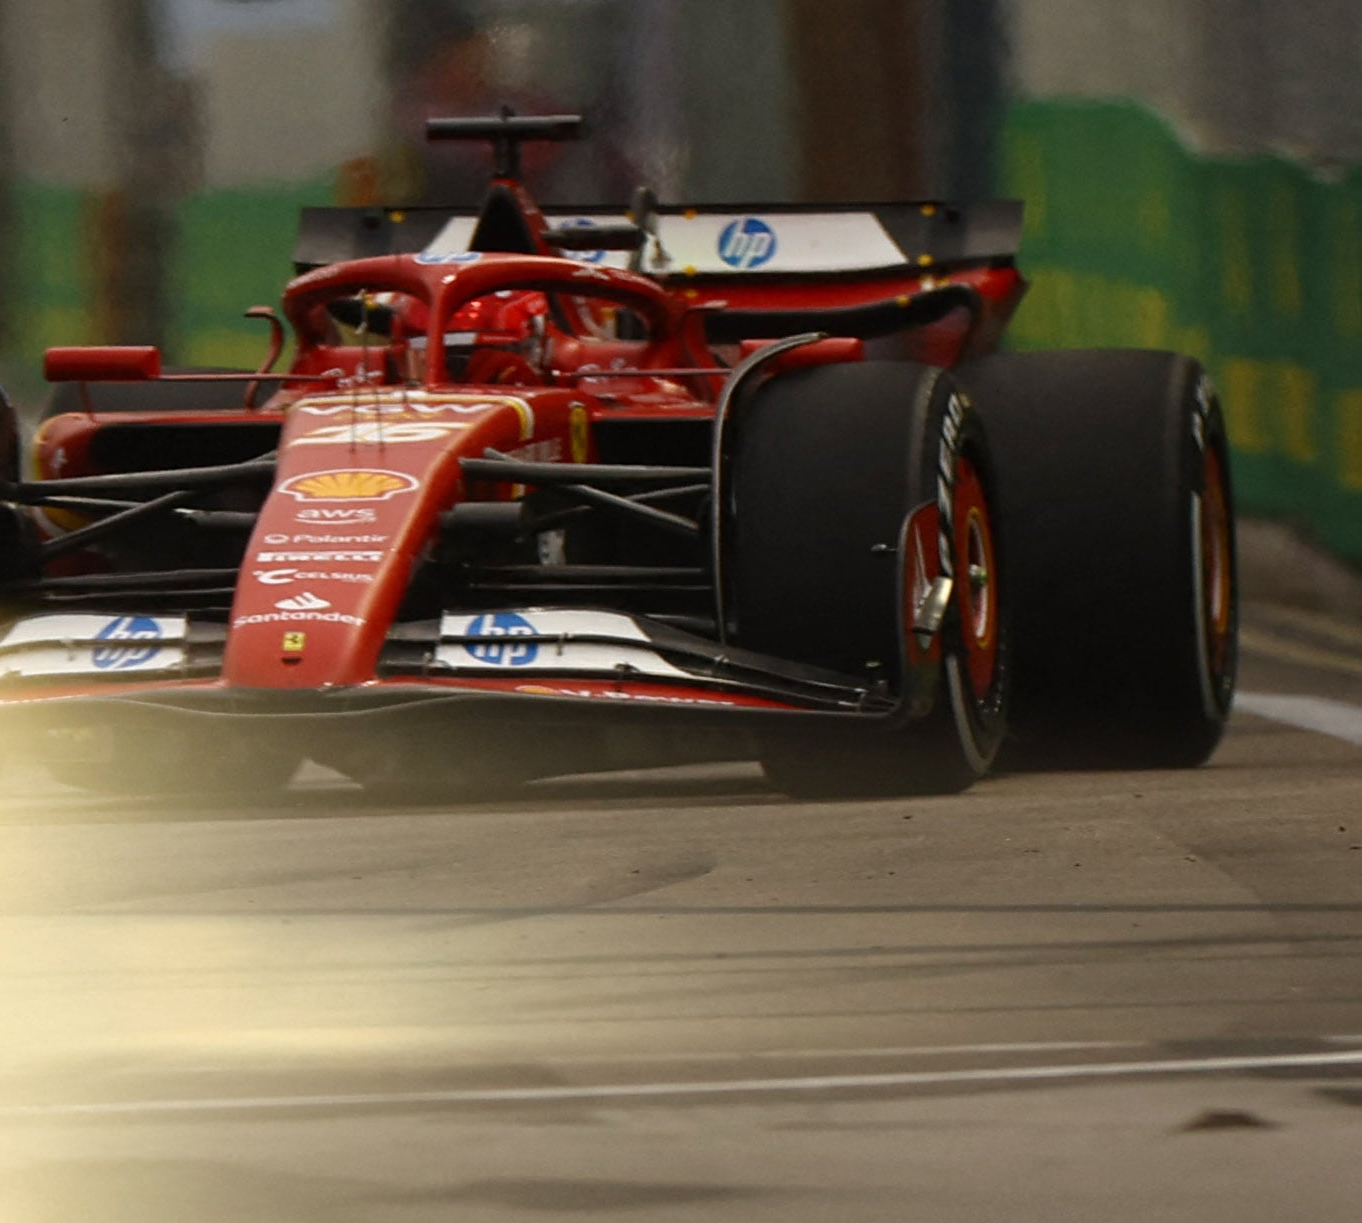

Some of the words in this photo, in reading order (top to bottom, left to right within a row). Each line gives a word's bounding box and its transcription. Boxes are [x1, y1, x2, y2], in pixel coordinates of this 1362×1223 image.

[721, 217, 776, 268] hp
[293, 534, 390, 544] Palantir
[297, 509, 376, 523] aws
[92, 616, 161, 669] hp
[466, 611, 539, 667] hp
